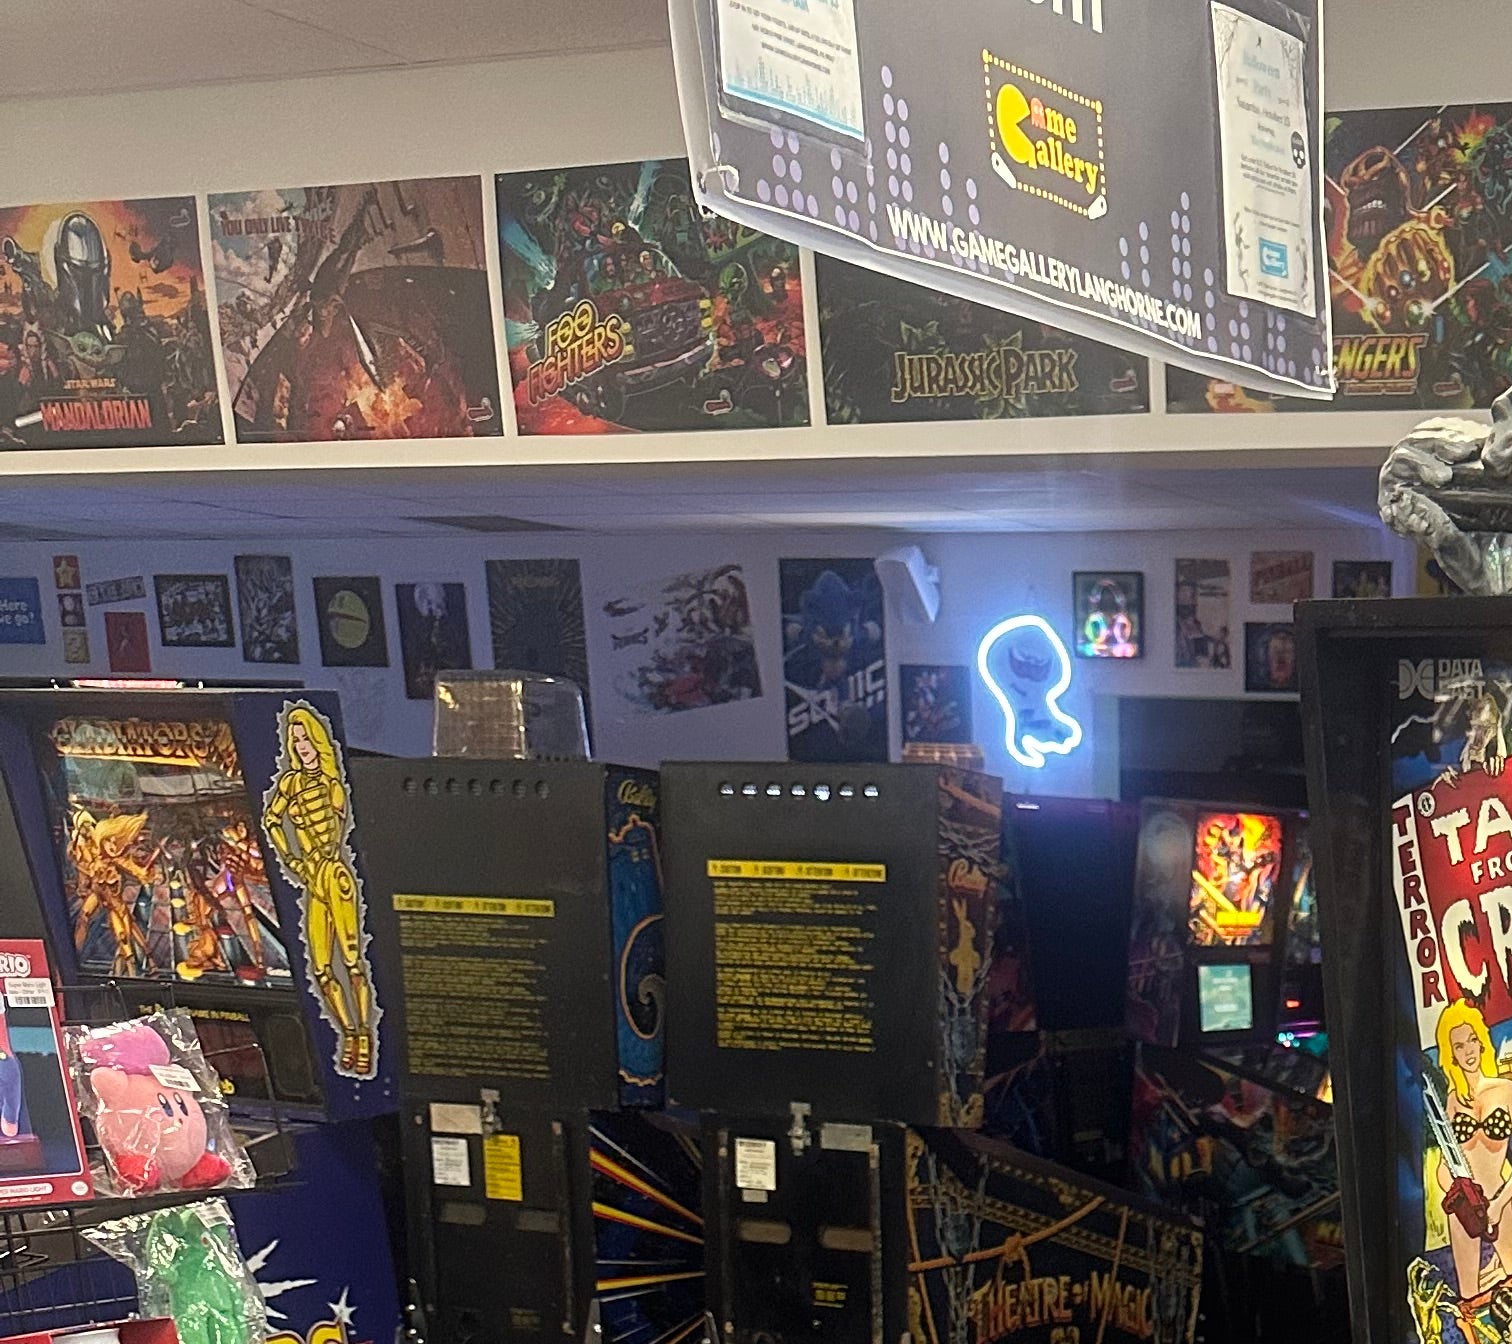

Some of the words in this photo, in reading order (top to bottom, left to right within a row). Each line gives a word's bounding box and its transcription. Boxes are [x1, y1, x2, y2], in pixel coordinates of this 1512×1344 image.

[222, 219, 242, 236] YOU
[245, 218, 269, 235] ONLY
[271, 216, 291, 233] LIVE
[886, 203, 1202, 340] WWW.GAMEGALLERYLANGHORNE.COM
[548, 302, 596, 349] FOO
[528, 318, 623, 403] FIGHTERS
[893, 350, 1000, 401] JURASSIC
[1001, 349, 1078, 395] PARK
[41, 399, 152, 431] MANDALORIAN
[1439, 659, 1483, 676] DATA
[1392, 805, 1446, 1008] TERROR
[1089, 1270, 1153, 1339] MAGIC
